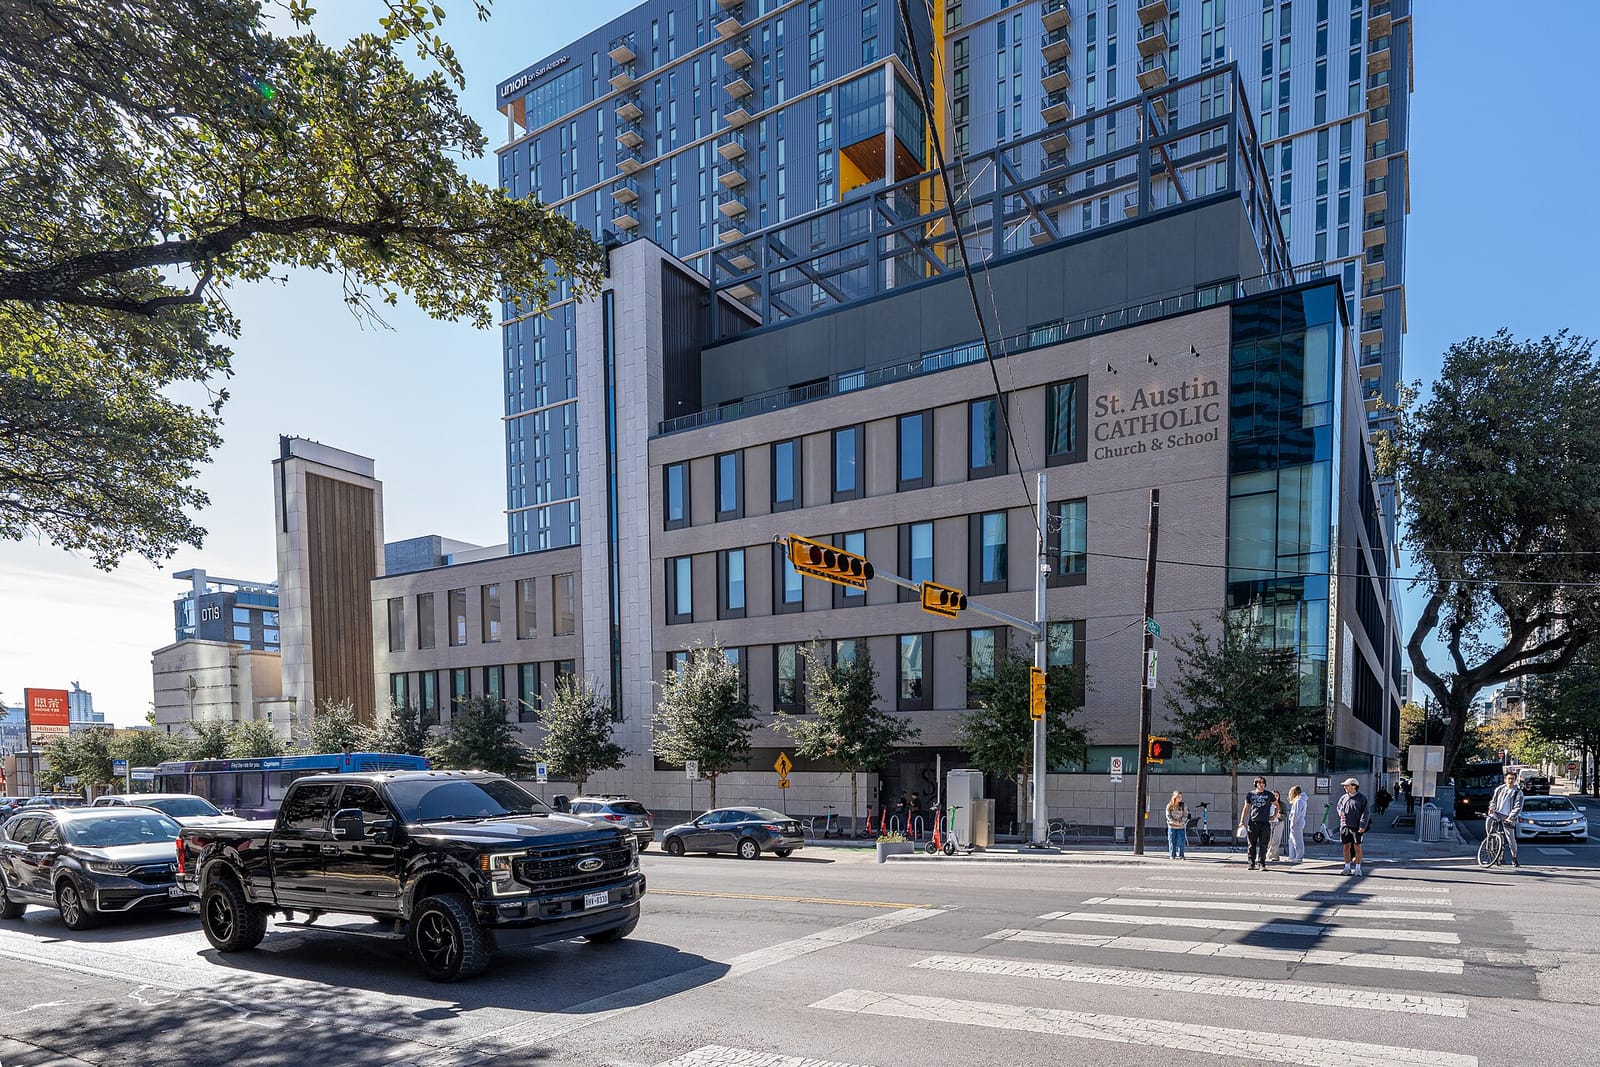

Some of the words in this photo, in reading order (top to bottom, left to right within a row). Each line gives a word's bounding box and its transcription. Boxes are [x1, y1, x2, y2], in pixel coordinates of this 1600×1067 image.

[501, 75, 528, 97] union
[528, 73, 536, 81] on
[535, 67, 546, 77] San
[546, 55, 567, 71] Antonio
[1094, 395, 1125, 418] St.
[1130, 377, 1220, 412] Austin
[1094, 402, 1220, 442] CATHOLIC
[1094, 441, 1147, 460] Church
[1151, 438, 1163, 451] &
[1167, 428, 1219, 449] School
[201, 606, 220, 621] OTIS
